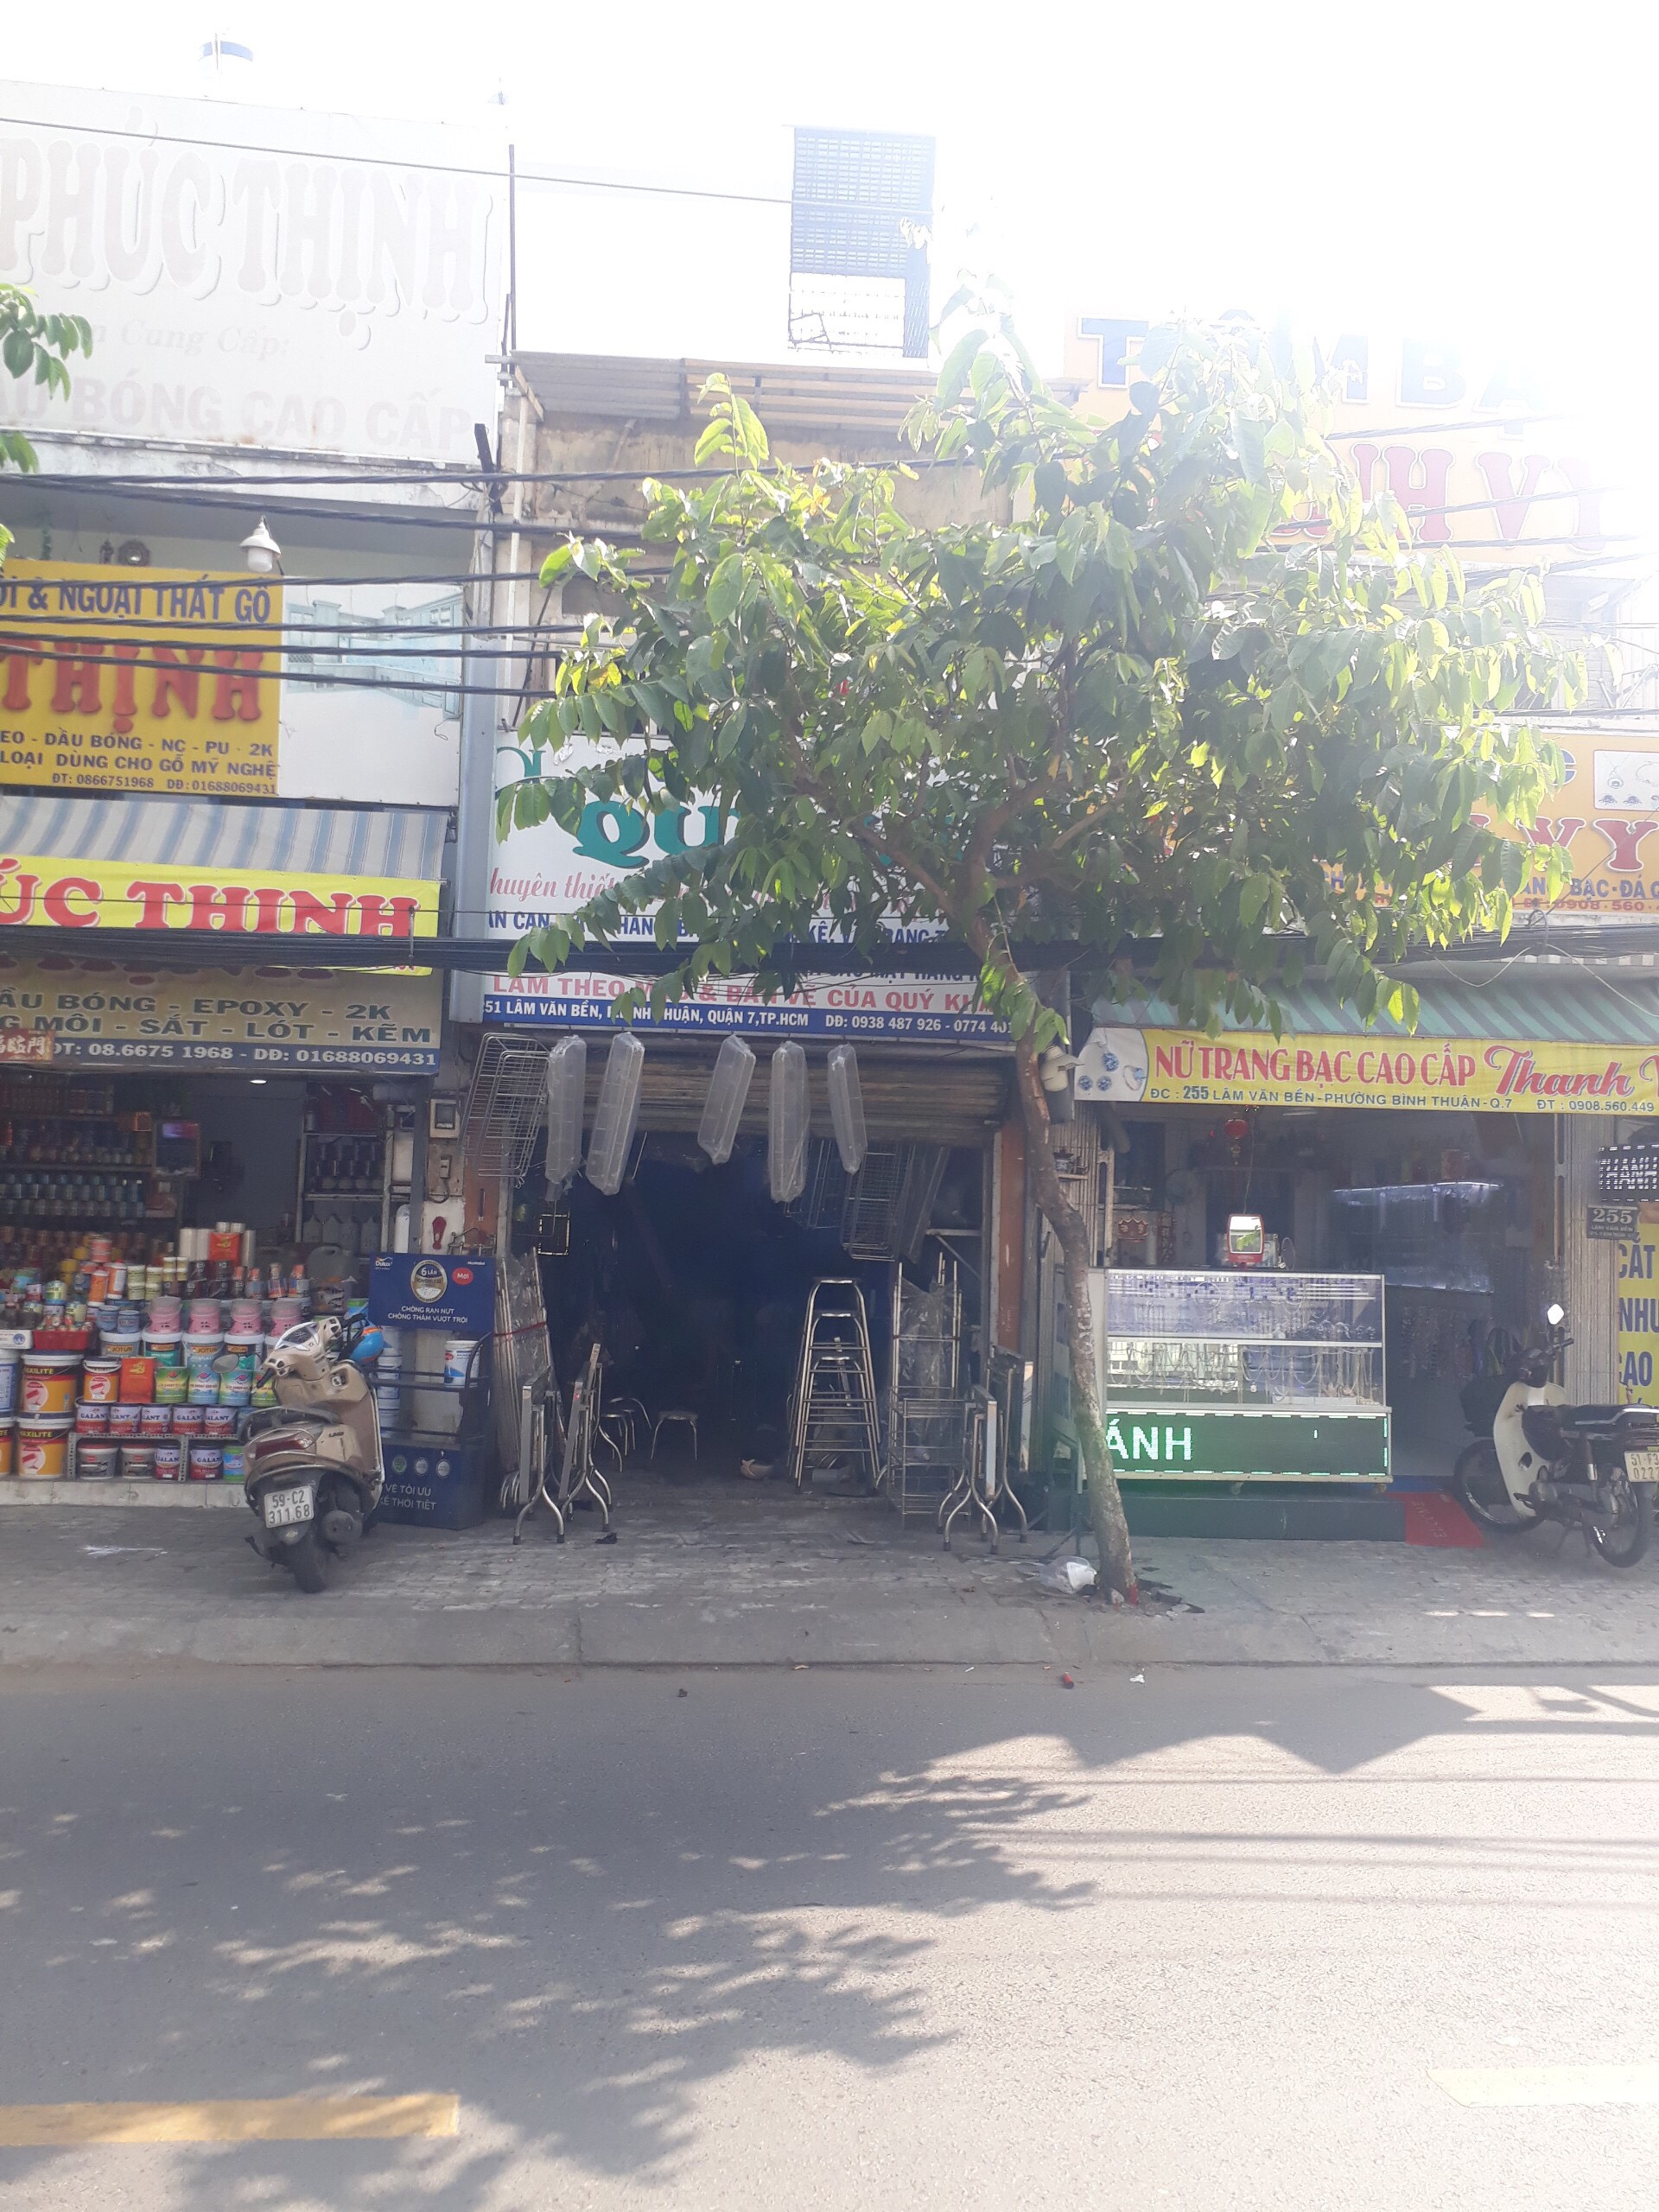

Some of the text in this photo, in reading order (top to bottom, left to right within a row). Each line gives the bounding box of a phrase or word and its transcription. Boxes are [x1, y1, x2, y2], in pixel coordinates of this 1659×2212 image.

[121, 319, 204, 356] Cung
[73, 367, 222, 434] BÓNG
[242, 389, 347, 443] CAO
[365, 386, 472, 451] CẤP
[45, 727, 83, 748] DẦU
[162, 739, 186, 753] NC
[206, 741, 230, 755] PU
[249, 743, 273, 757] 2K
[56, 751, 108, 770] DÙNG
[115, 756, 153, 771] CHO
[227, 760, 276, 780] NGHỆ
[57, 992, 157, 1012] BÓNG
[194, 998, 309, 1018] EPOXY
[346, 1004, 391, 1020] 2K
[557, 978, 626, 997] THEO
[827, 982, 877, 1008] CỦA
[886, 988, 934, 1012] QUÝ
[34, 1013, 102, 1033] MÔI
[139, 1014, 209, 1036] SẮT
[246, 1020, 315, 1039] LÓT
[352, 1023, 431, 1043] KẼM
[505, 999, 536, 1015] LÂM
[540, 1000, 567, 1016] VĂN
[707, 1007, 743, 1024] QUẬN
[825, 1014, 849, 1028] DĐ:
[851, 1014, 885, 1030] 0938
[888, 1016, 912, 1031] 487
[917, 1018, 941, 1032] 926
[954, 1020, 987, 1033] 0774
[88, 1043, 174, 1058] 08.6675
[182, 1045, 233, 1059] 1968
[254, 1048, 289, 1062] DĐ:
[296, 1049, 436, 1066] 01688069431
[1156, 1039, 1195, 1079] NỮ
[1198, 1046, 1291, 1082] TRANG
[1296, 1049, 1352, 1090] BẠC
[1357, 1050, 1416, 1086] CAO
[1421, 1042, 1477, 1087] CẤP
[1484, 1045, 1635, 1097] Thanh
[1182, 1085, 1210, 1101] 255
[1212, 1087, 1243, 1102] LÂM
[1248, 1088, 1279, 1103] VĂN
[1325, 1090, 1387, 1105] PHƯỜNG
[1392, 1094, 1426, 1107] BÌNH
[1431, 1094, 1481, 1110] THUẬN
[1490, 1097, 1513, 1109] Q.7
[1568, 1100, 1655, 1113] 0908.560.449
[1592, 1208, 1633, 1224] 255
[1105, 1418, 1192, 1461] ÁNH
[268, 1503, 311, 1525] 311.68
[272, 1490, 305, 1509] 59-C2
